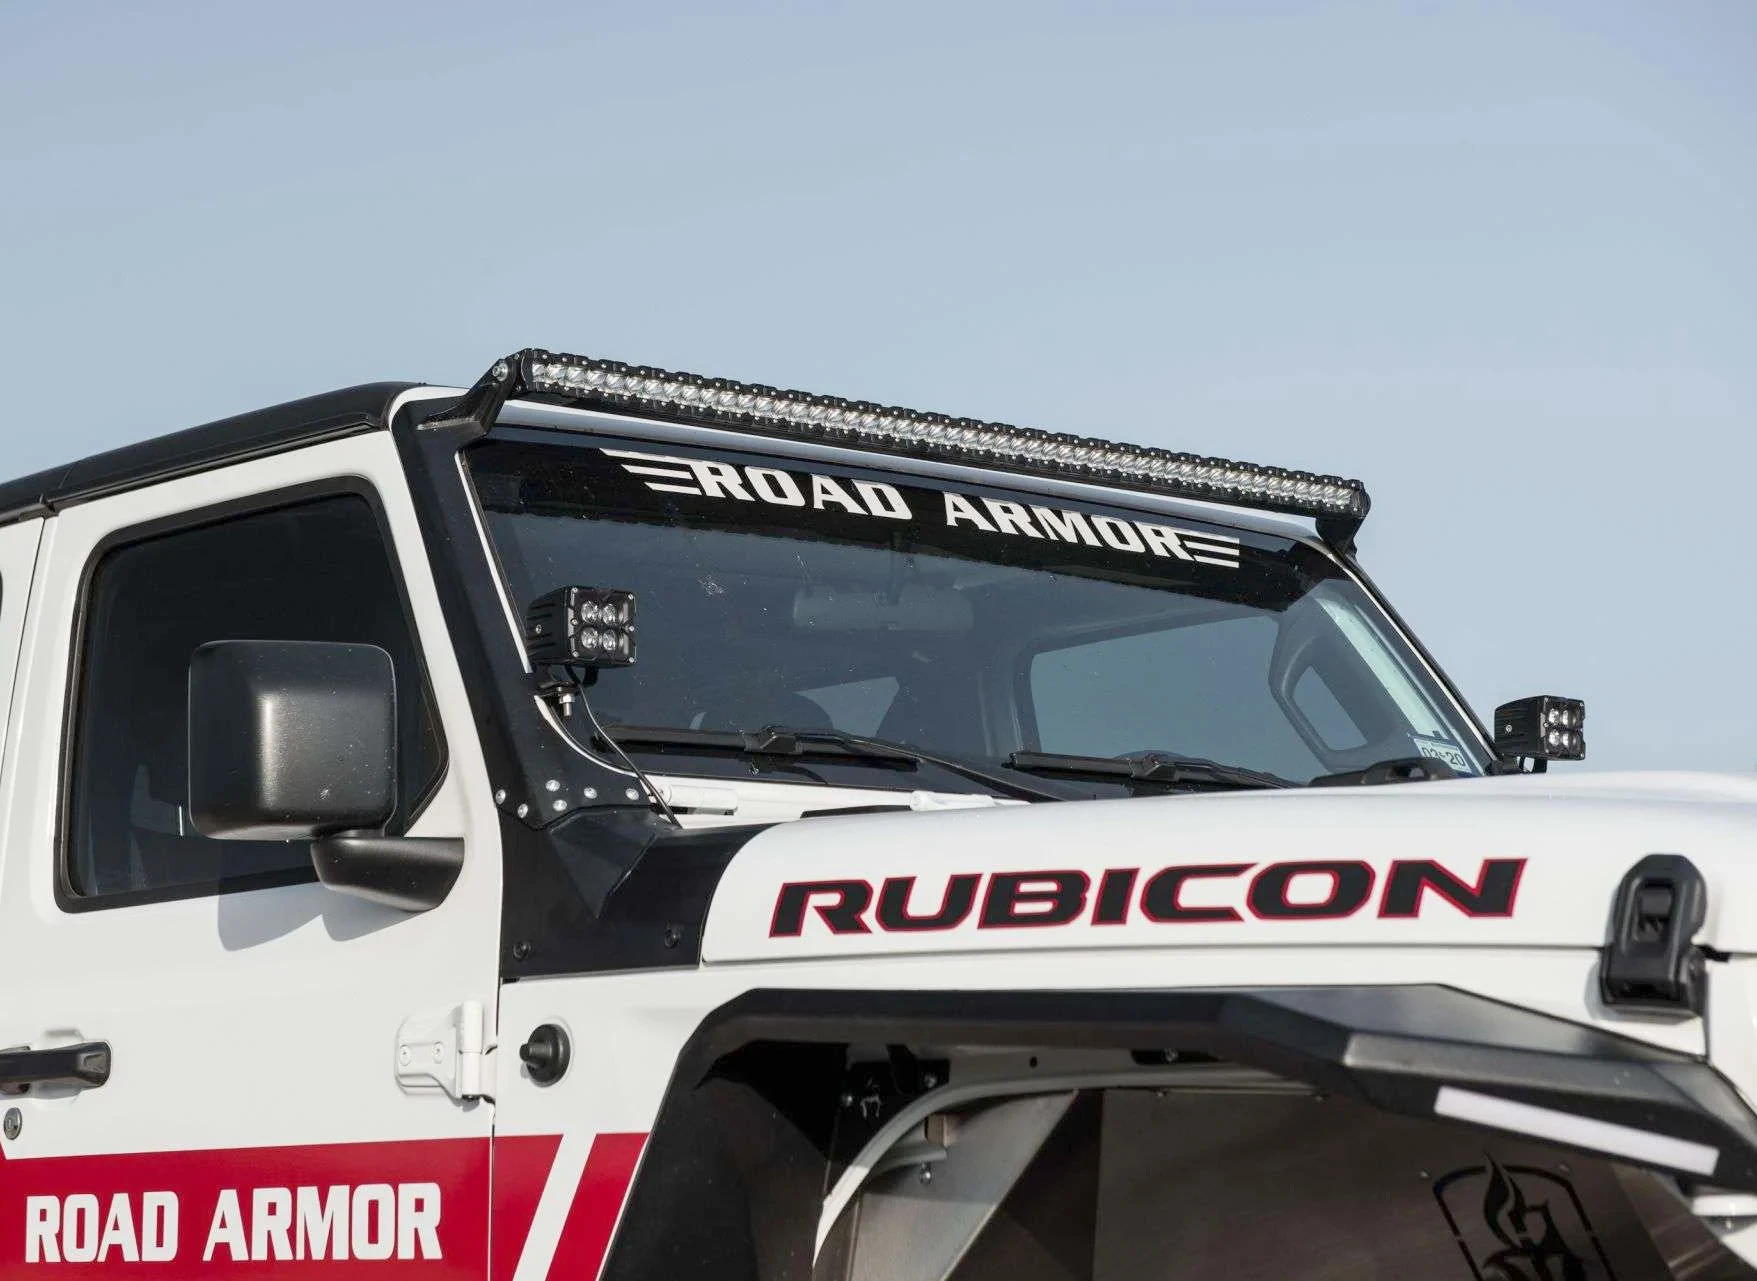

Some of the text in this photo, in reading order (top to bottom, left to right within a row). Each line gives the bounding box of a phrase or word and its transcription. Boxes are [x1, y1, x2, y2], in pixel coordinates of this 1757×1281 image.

[698, 462, 1194, 561] ROAD ARMOR
[769, 858, 1528, 938] RUBICON
[25, 1183, 443, 1263] ROAD ARMOR
